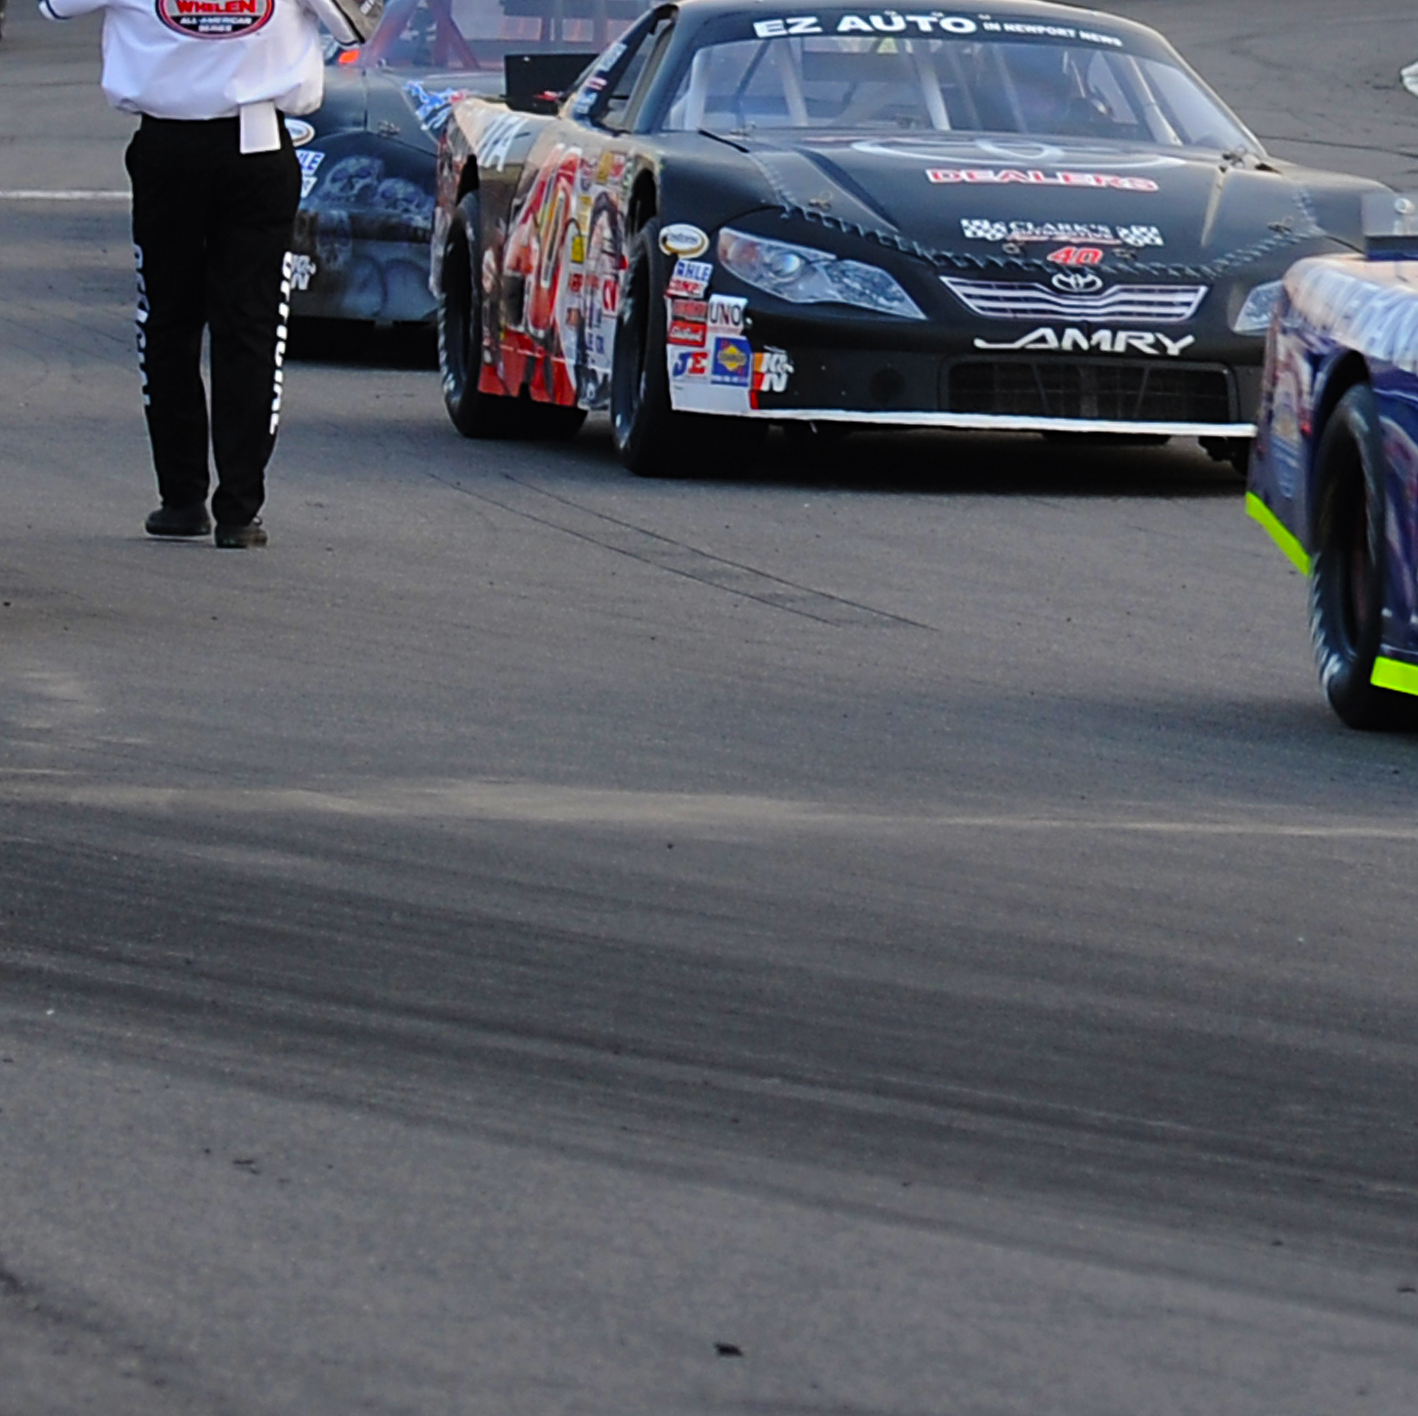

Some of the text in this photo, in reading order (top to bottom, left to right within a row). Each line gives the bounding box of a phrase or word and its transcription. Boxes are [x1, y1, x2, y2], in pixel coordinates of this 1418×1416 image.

[753, 13, 1123, 48] EZ AUTO IN NEWPORT NEWS
[926, 168, 1159, 192] DEALERS
[1047, 246, 1104, 265] 40
[672, 351, 708, 377] JE
